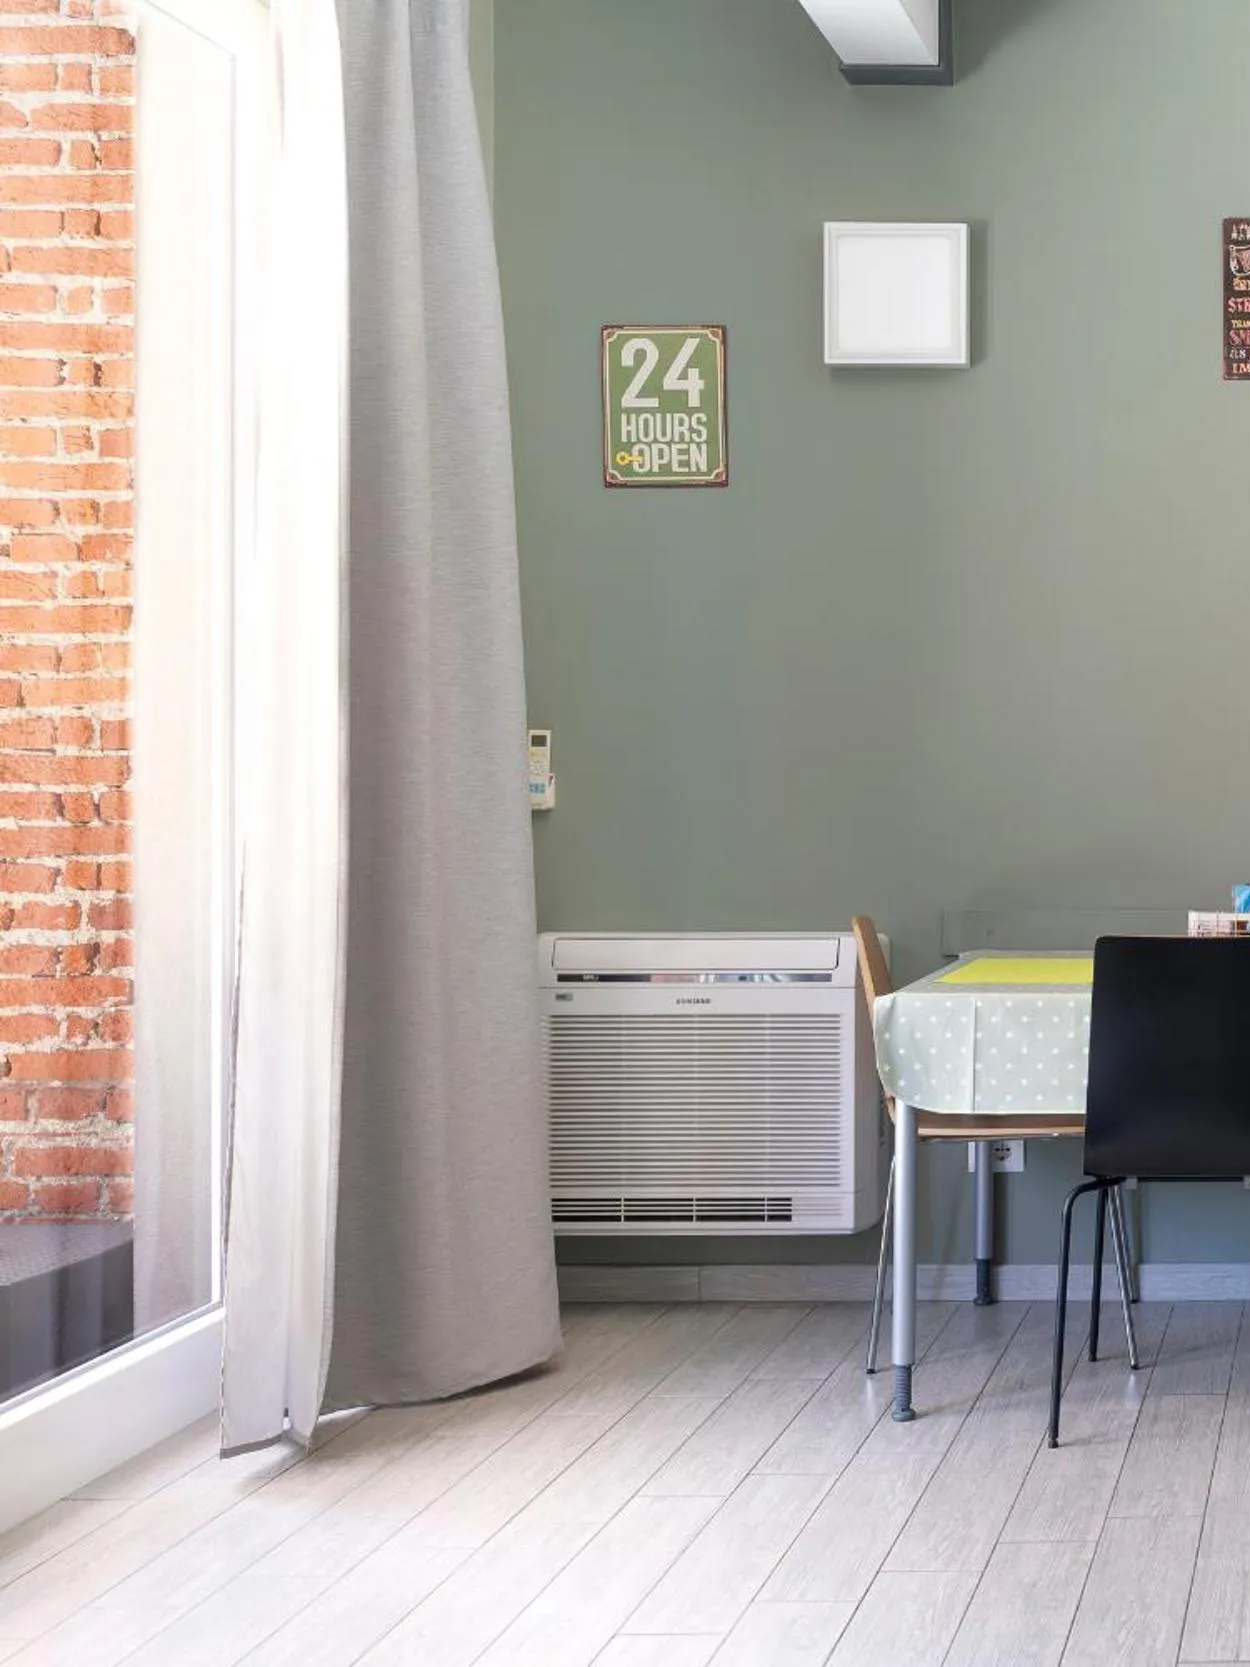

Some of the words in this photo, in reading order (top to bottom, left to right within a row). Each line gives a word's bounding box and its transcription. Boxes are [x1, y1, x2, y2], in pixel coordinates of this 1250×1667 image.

[621, 337, 705, 408] 24
[621, 413, 708, 443] HOURS
[631, 443, 708, 473] OPEN
